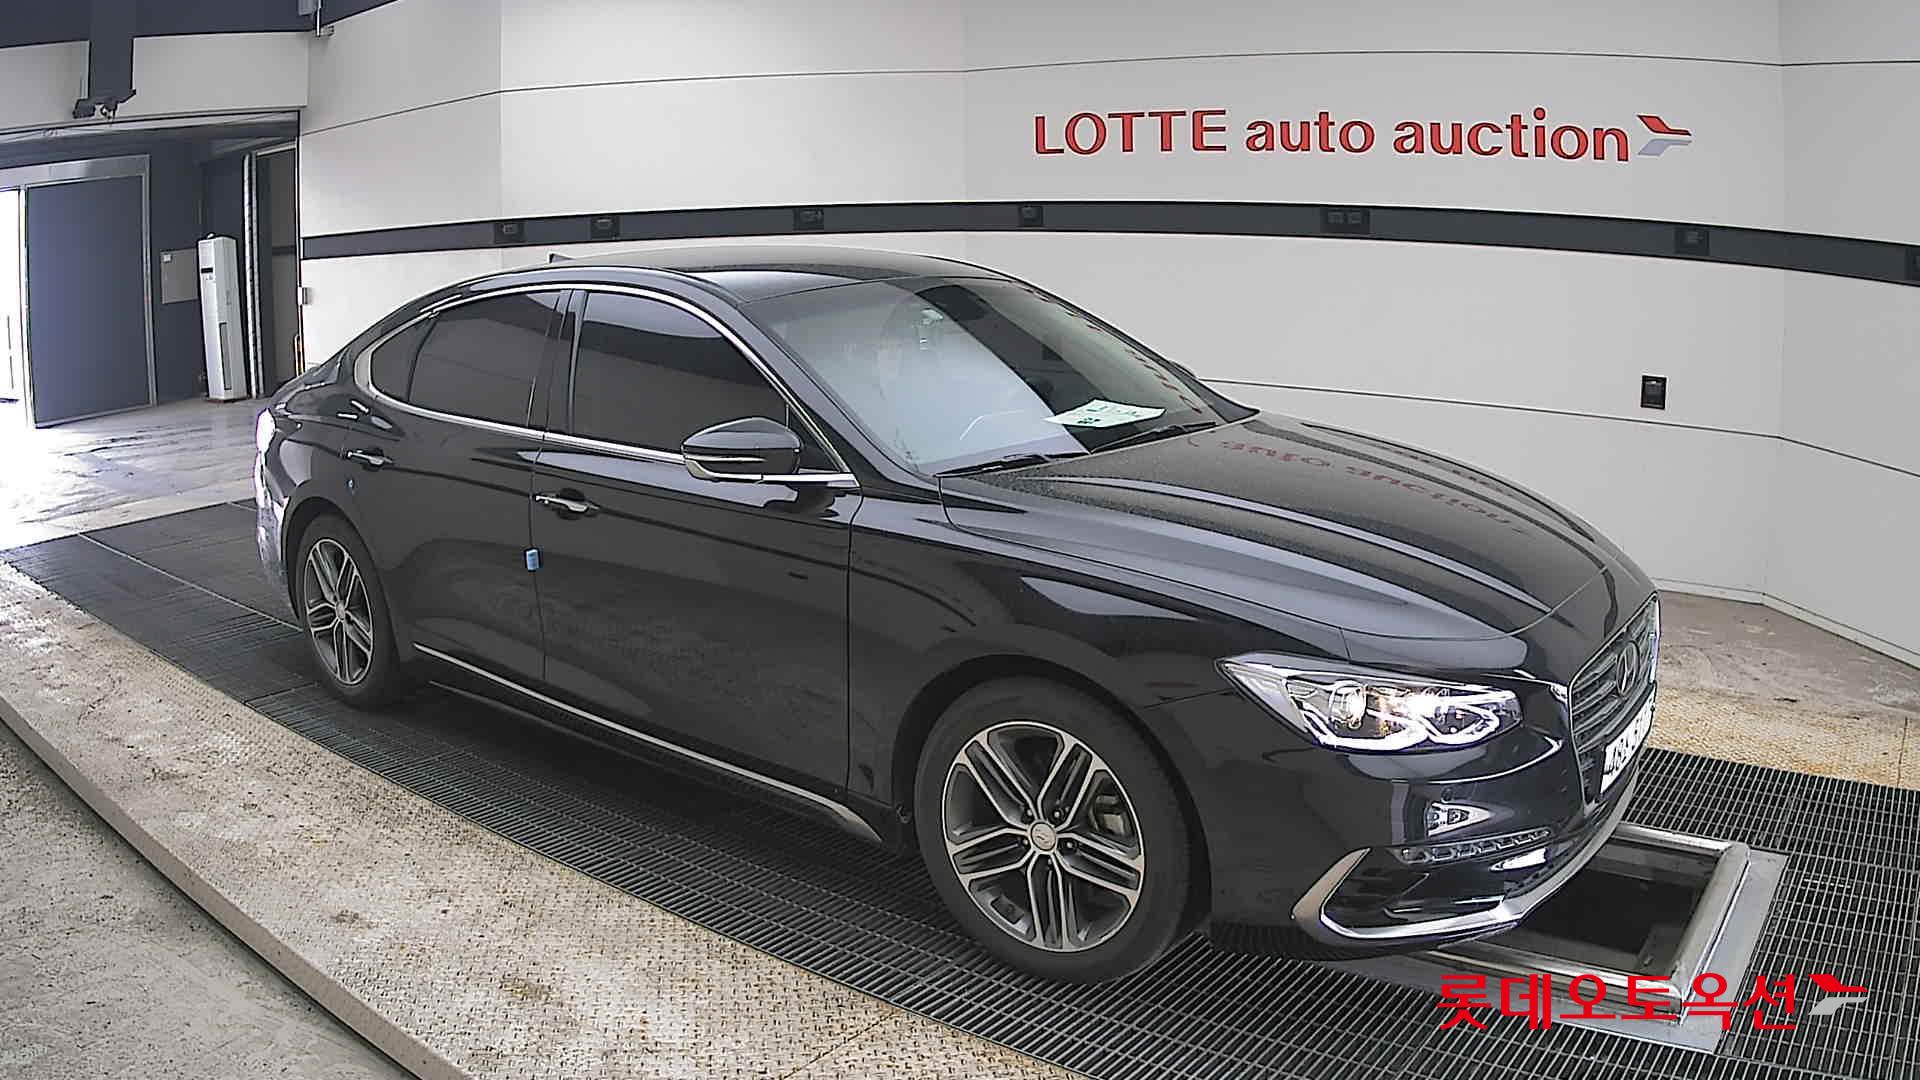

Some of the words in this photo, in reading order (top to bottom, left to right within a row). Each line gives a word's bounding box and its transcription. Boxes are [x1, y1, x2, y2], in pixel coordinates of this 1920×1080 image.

[1035, 109, 1227, 154] LOTTE
[1245, 112, 1375, 153] auto
[1393, 107, 1630, 161] auction
